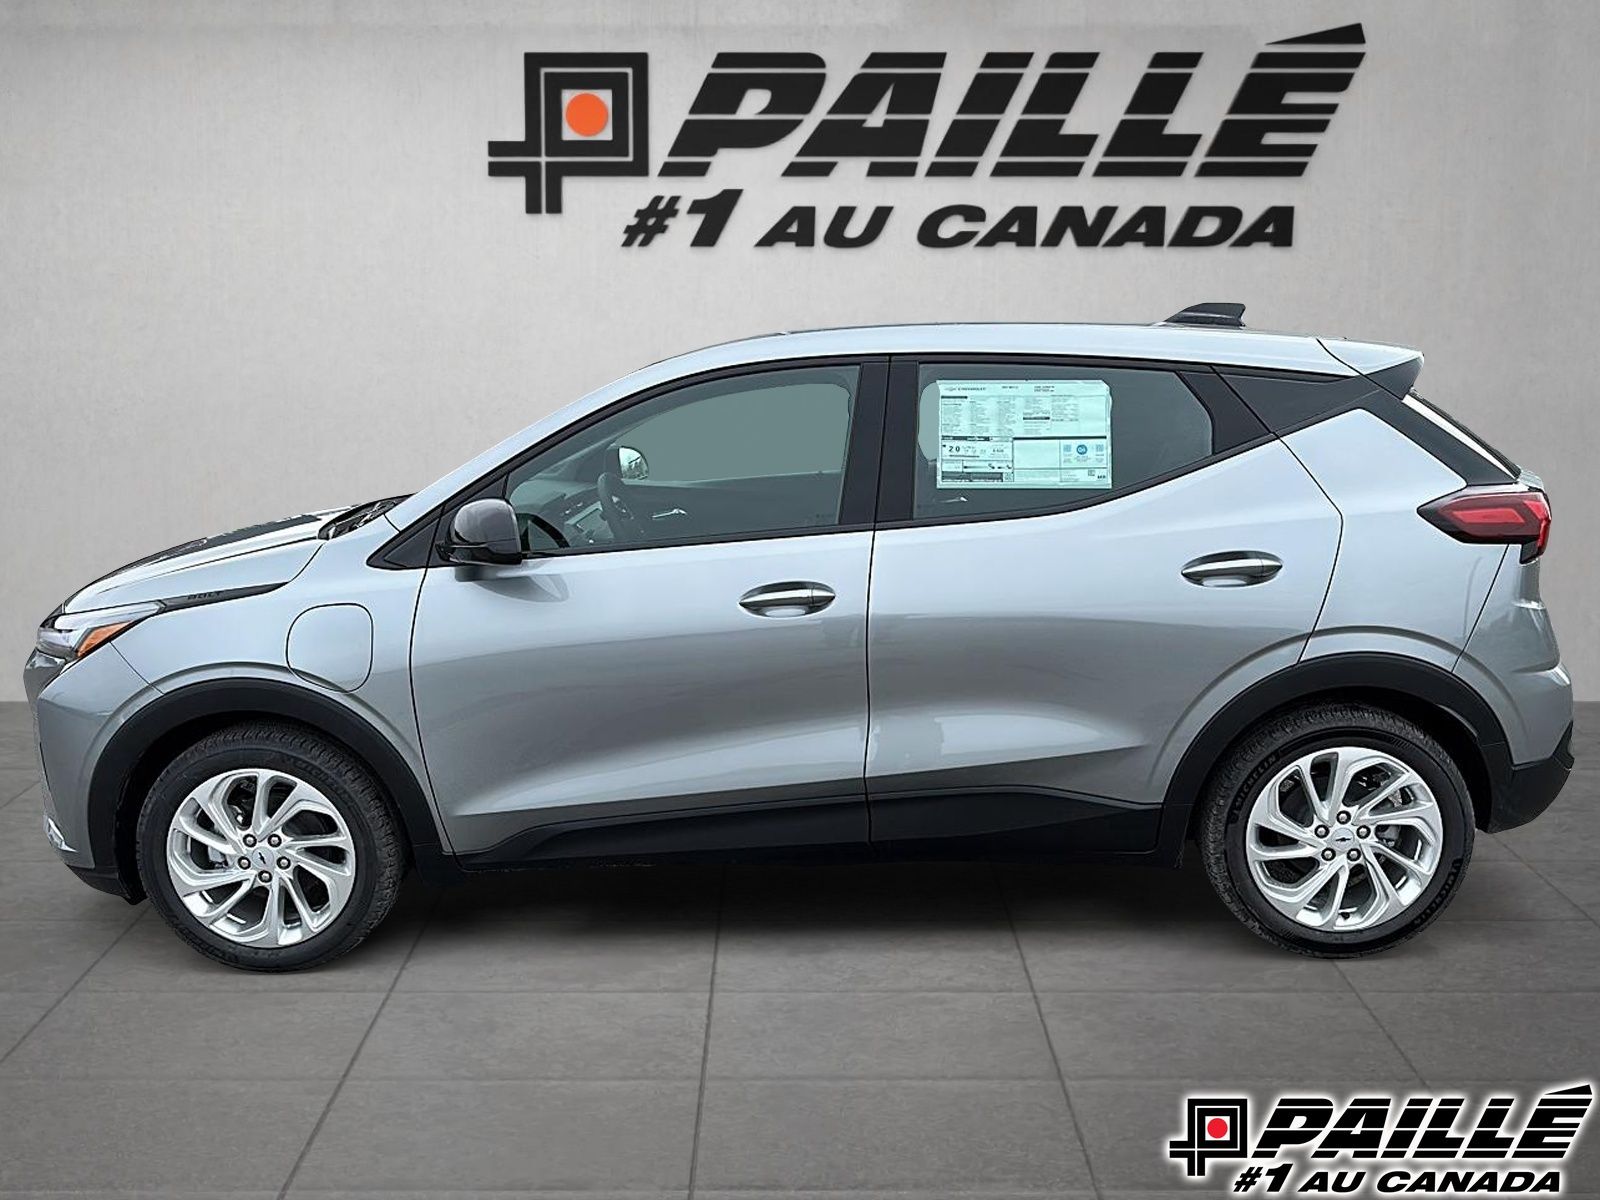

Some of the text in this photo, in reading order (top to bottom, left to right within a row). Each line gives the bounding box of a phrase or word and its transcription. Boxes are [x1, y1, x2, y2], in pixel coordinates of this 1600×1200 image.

[658, 23, 1366, 177] PAILLÉ
[622, 189, 1294, 248] #1 AU CANADA
